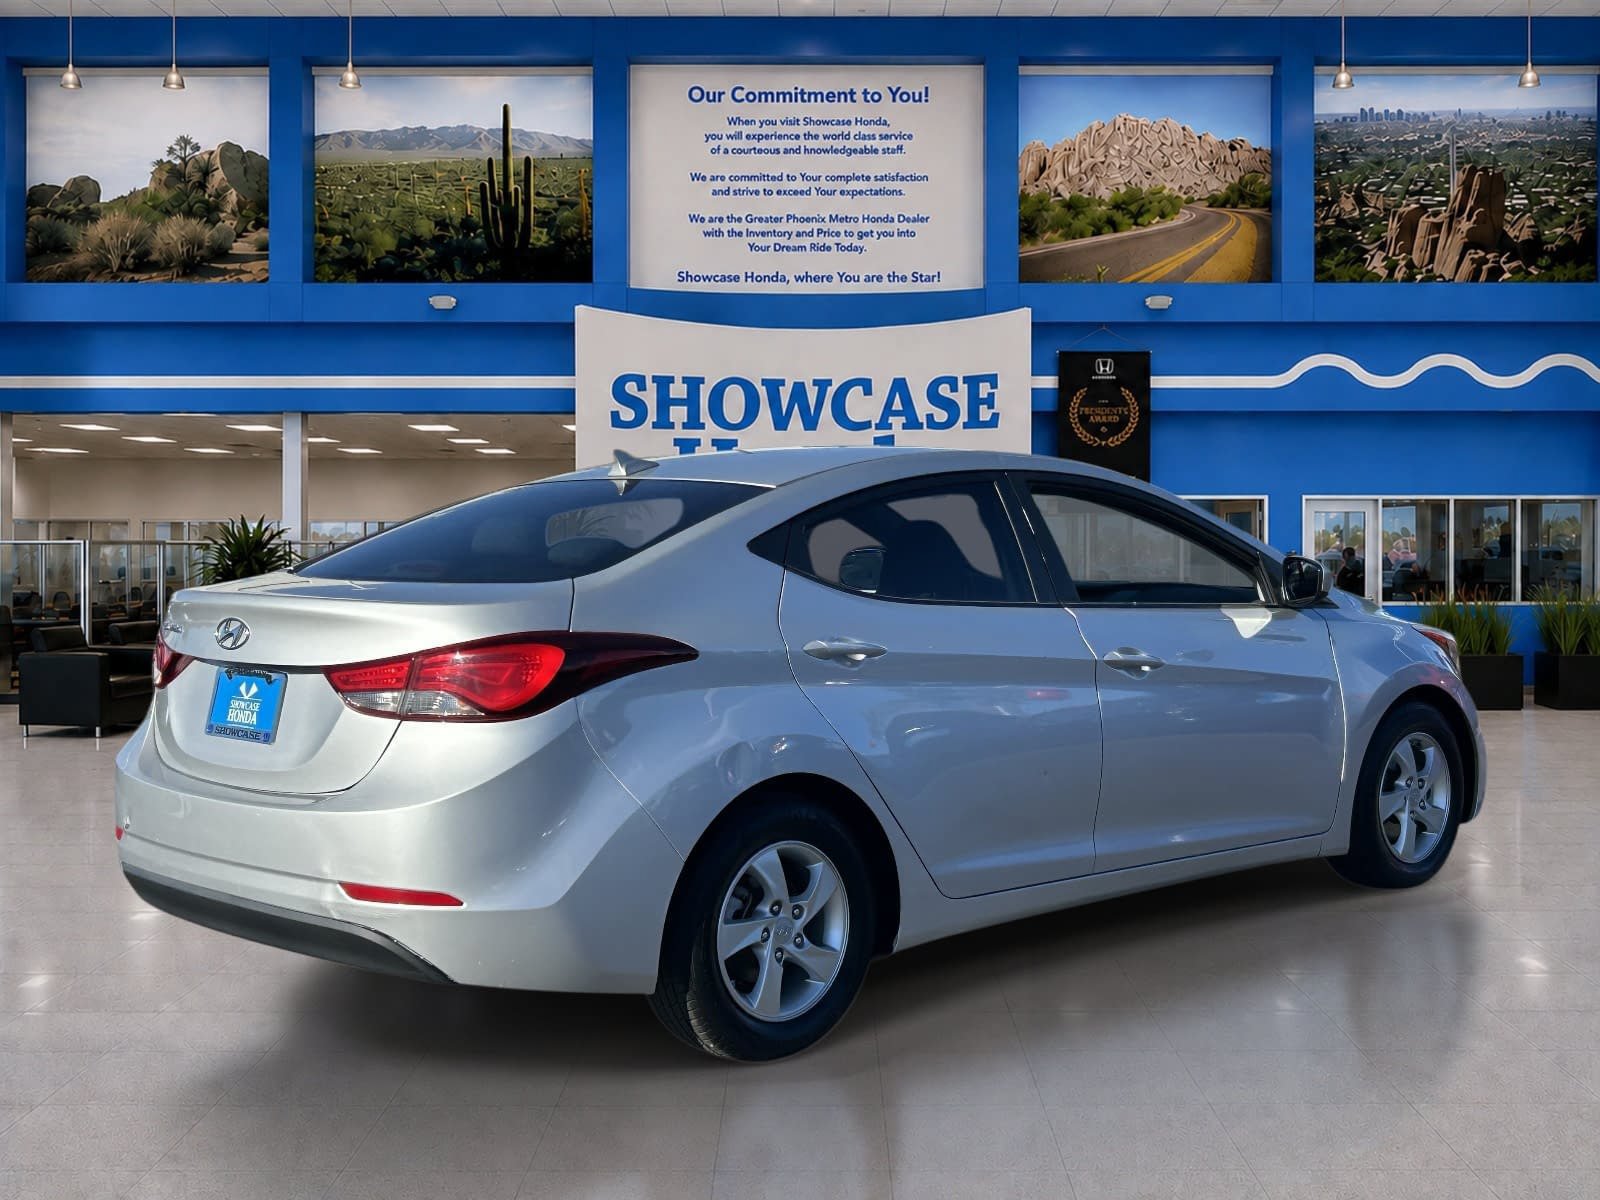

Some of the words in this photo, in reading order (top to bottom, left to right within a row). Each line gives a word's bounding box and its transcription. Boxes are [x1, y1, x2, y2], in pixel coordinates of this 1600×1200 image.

[688, 85, 726, 103] Our
[730, 86, 857, 104] Commitment
[861, 88, 883, 103] to
[886, 86, 929, 103] You!
[726, 116, 756, 126] When
[758, 119, 777, 129] you
[779, 116, 801, 126] visit
[802, 116, 852, 127] Showcase
[854, 116, 890, 128] Honda,
[704, 133, 723, 143] you
[725, 130, 743, 141] will
[745, 131, 801, 143] experience
[803, 130, 820, 141] the
[822, 130, 851, 141] world
[853, 131, 877, 141] class
[878, 131, 913, 141] service
[710, 144, 721, 155] of
[723, 147, 729, 155] a
[731, 146, 781, 155] courteous
[783, 145, 802, 155] and
[881, 144, 906, 155] staff.
[689, 172, 707, 182] We
[728, 172, 784, 182] committed
[786, 173, 797, 182] to
[799, 172, 822, 182] Your
[825, 172, 872, 184] complete
[873, 172, 929, 182] satisfaction
[711, 186, 731, 196] and
[732, 186, 761, 196] strive
[763, 188, 774, 196] to
[775, 186, 812, 196] exceed
[814, 186, 838, 196] Your
[839, 186, 905, 199] expectations.
[688, 213, 706, 224] We
[707, 216, 724, 224] are
[726, 213, 743, 224] the
[745, 213, 784, 224] Greater
[786, 213, 826, 224] Phoenix
[829, 214, 859, 224] Metro
[862, 213, 895, 224] Honda
[897, 213, 930, 224] Dealer
[702, 227, 725, 238] with
[727, 227, 744, 238] the
[746, 228, 793, 240] Inventory
[795, 227, 814, 238] and
[816, 228, 842, 238] Price
[844, 229, 855, 238] to
[857, 229, 874, 240] get
[876, 230, 895, 240] you
[897, 228, 916, 238] into
[747, 242, 771, 252] Your
[773, 242, 807, 253] Dream
[809, 242, 832, 252] Ride
[834, 242, 867, 255] Today.
[677, 270, 741, 283] Showcase
[744, 271, 790, 285] Honda,
[794, 271, 834, 283] where
[836, 271, 860, 283] You
[863, 274, 884, 283] are
[886, 271, 908, 283] the
[911, 271, 941, 283] Star!
[610, 373, 1000, 431] SHOWCASE
[230, 700, 260, 711] SHOWCASE
[227, 708, 257, 725] HONDA
[214, 726, 261, 740] SHOWCASE
